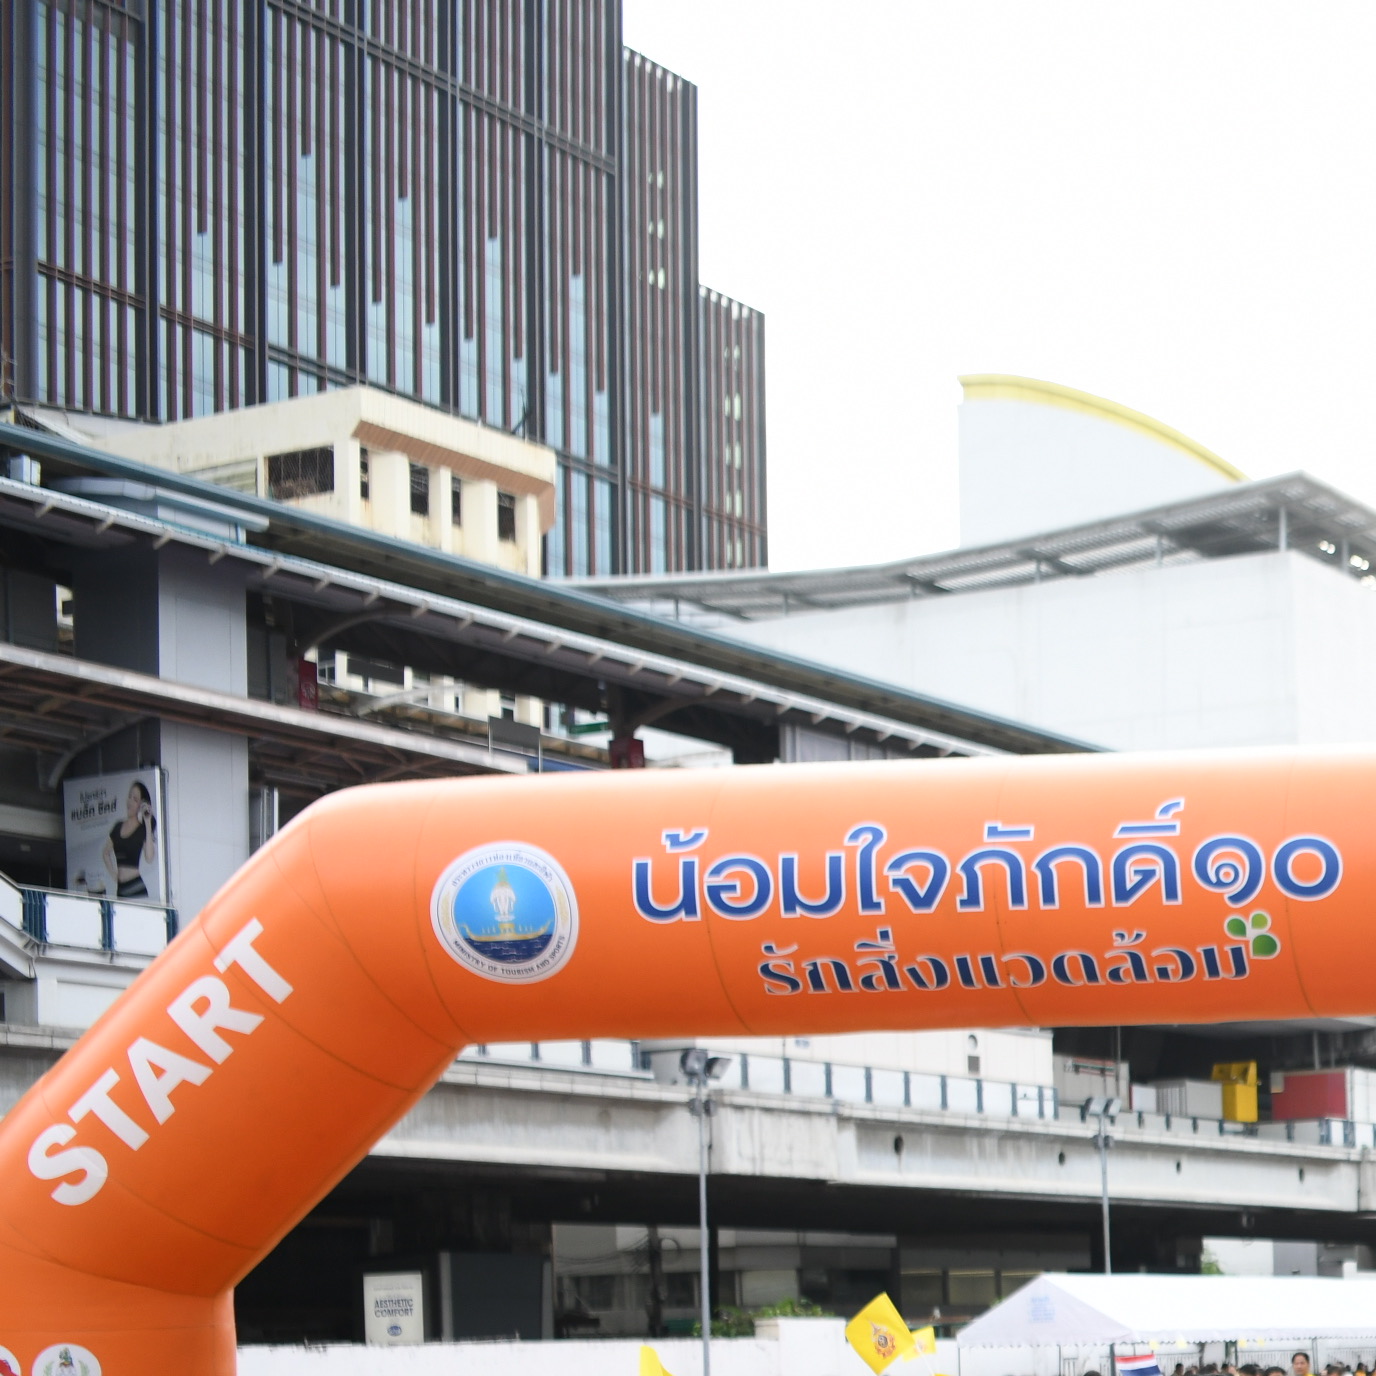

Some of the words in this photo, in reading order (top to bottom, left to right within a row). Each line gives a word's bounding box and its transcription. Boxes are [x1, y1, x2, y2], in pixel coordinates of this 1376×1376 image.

[453, 938, 486, 969] MINISTRY
[487, 962, 499, 972] OF
[501, 964, 536, 976] TOURISM
[535, 957, 551, 973] AND
[549, 934, 566, 961] SPORTS
[758, 926, 1250, 996] รักสิ่งแวดล้อม
[27, 917, 293, 1206] START
[374, 1298, 414, 1309] AESTHETIC
[374, 1308, 414, 1319] COMFORT
